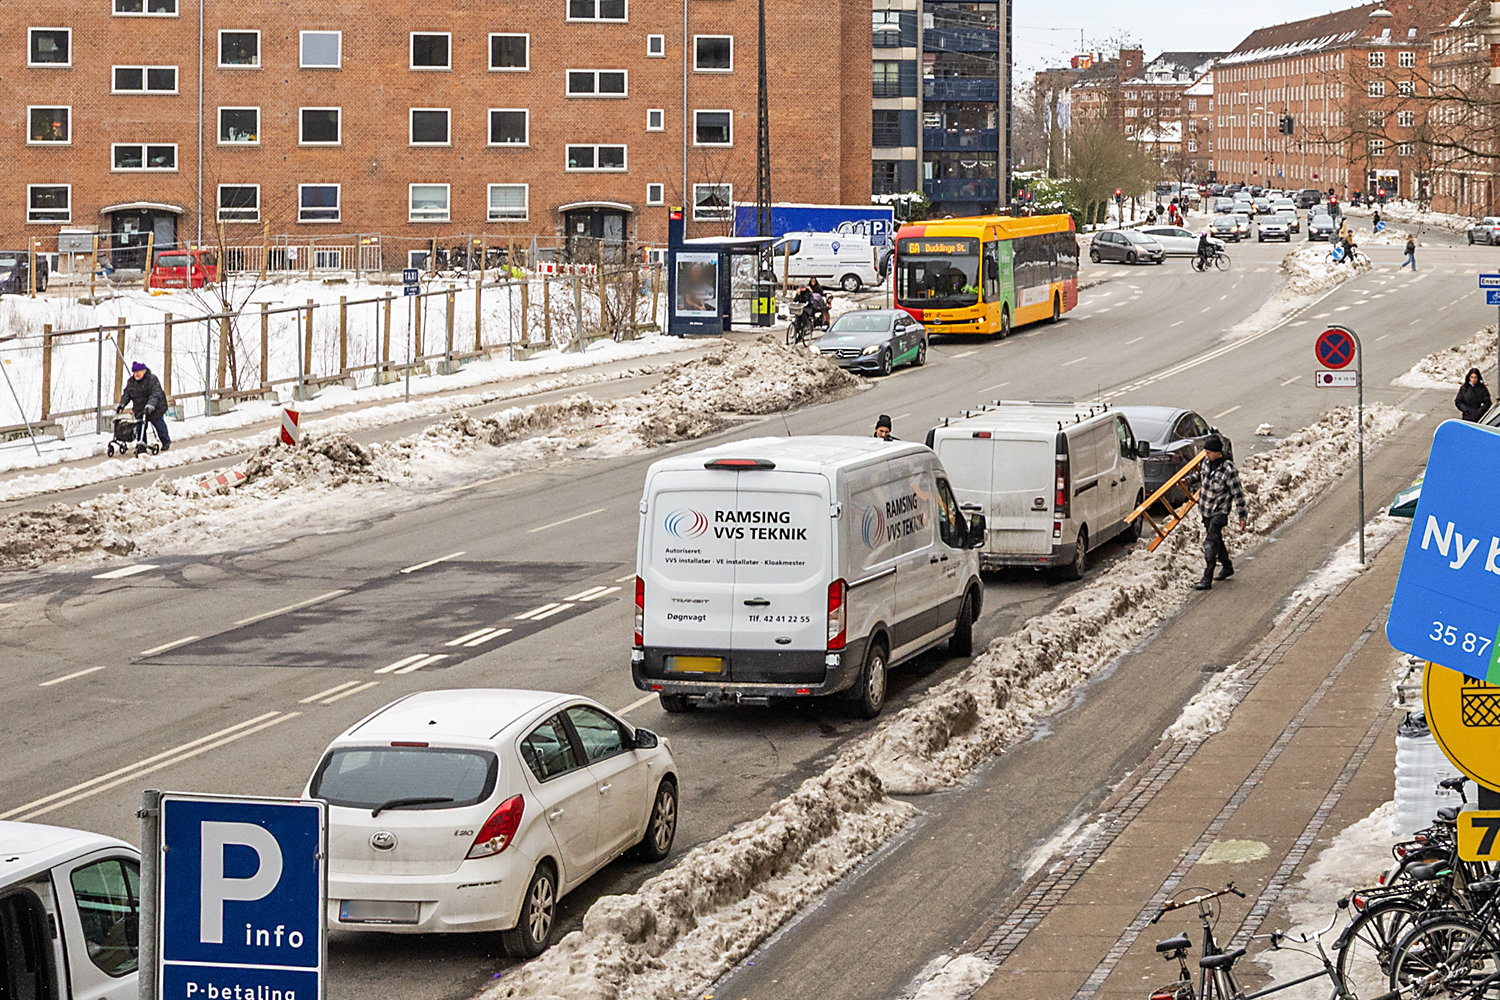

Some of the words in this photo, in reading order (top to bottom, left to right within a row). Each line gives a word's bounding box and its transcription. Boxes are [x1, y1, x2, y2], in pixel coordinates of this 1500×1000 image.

[873, 221, 883, 235] P
[909, 242, 920, 254] 6A
[925, 243, 956, 254] Buddinge
[956, 243, 967, 252] St.
[404, 271, 416, 280] TAXI
[886, 492, 918, 519] RAMSING
[714, 510, 790, 524] RAMSING
[714, 526, 744, 540] VVS
[750, 528, 807, 540] TEKNIK
[886, 519, 901, 542] VVS
[1420, 514, 1479, 571] Ny
[667, 613, 706, 623] Døgnvagt
[764, 615, 773, 623] 42
[776, 615, 785, 623] 41
[788, 615, 797, 623] 22
[800, 615, 810, 623] 55
[1428, 621, 1458, 650] 35
[1461, 630, 1492, 658] 87
[200, 820, 283, 943] P
[245, 923, 304, 948] info
[186, 981, 296, 1000] P-betaling
